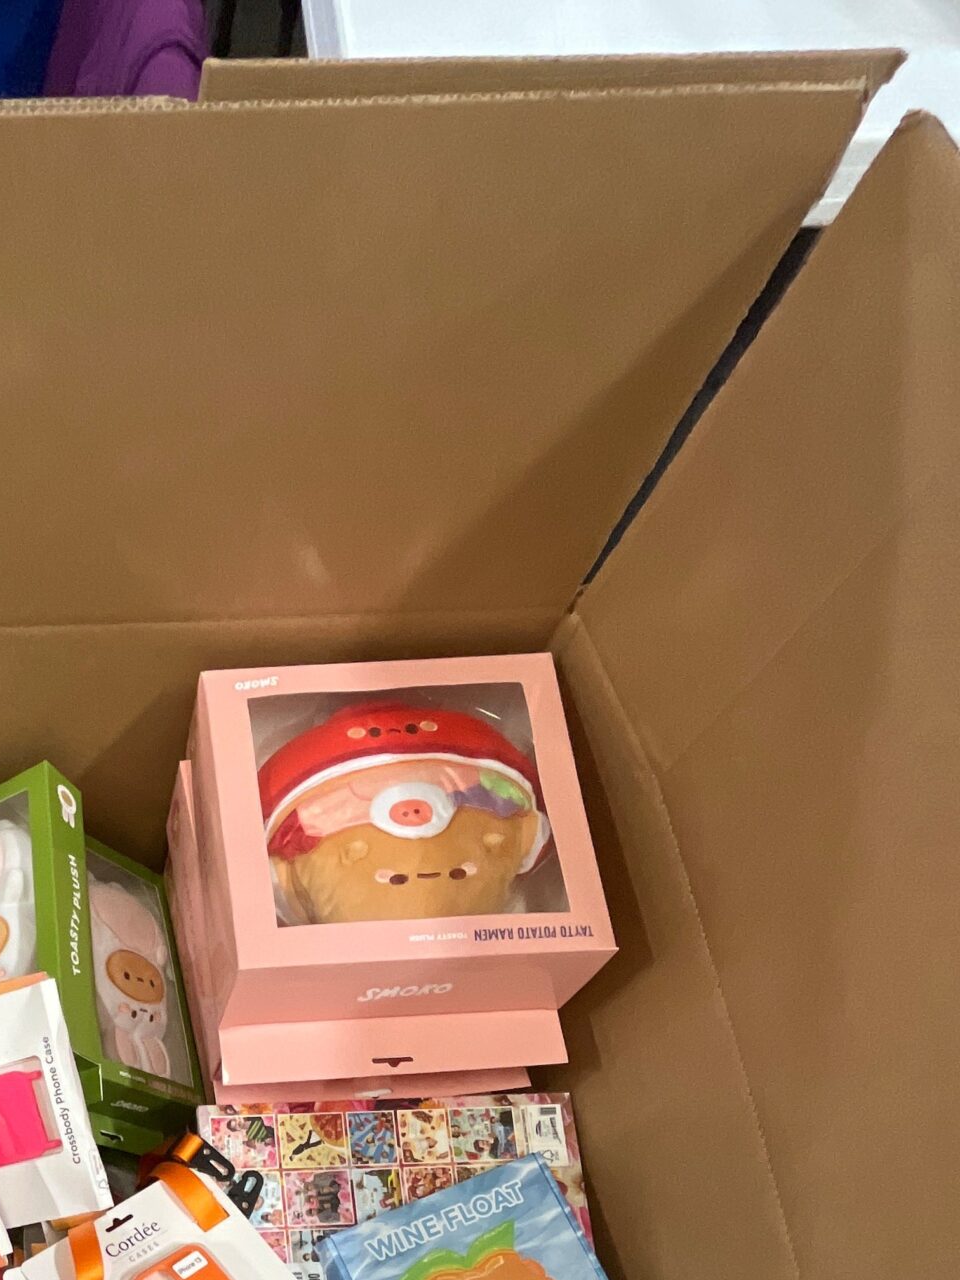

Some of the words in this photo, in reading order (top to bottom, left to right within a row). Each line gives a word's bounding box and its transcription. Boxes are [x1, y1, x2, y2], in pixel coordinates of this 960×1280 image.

[68, 854, 82, 911] PLUSH
[68, 909, 82, 976] TOASTY
[473, 928, 515, 942] RAMEN
[516, 926, 558, 940] POTATO
[559, 925, 594, 938] TAYTO
[356, 983, 454, 1003] SMOKO
[42, 1036, 55, 1065] Case
[49, 1066, 66, 1106] Phone
[59, 1106, 82, 1166] Crossbody
[105, 1220, 161, 1258] Cordée
[363, 1214, 442, 1262] WINE
[439, 1180, 525, 1233] FLOAT
